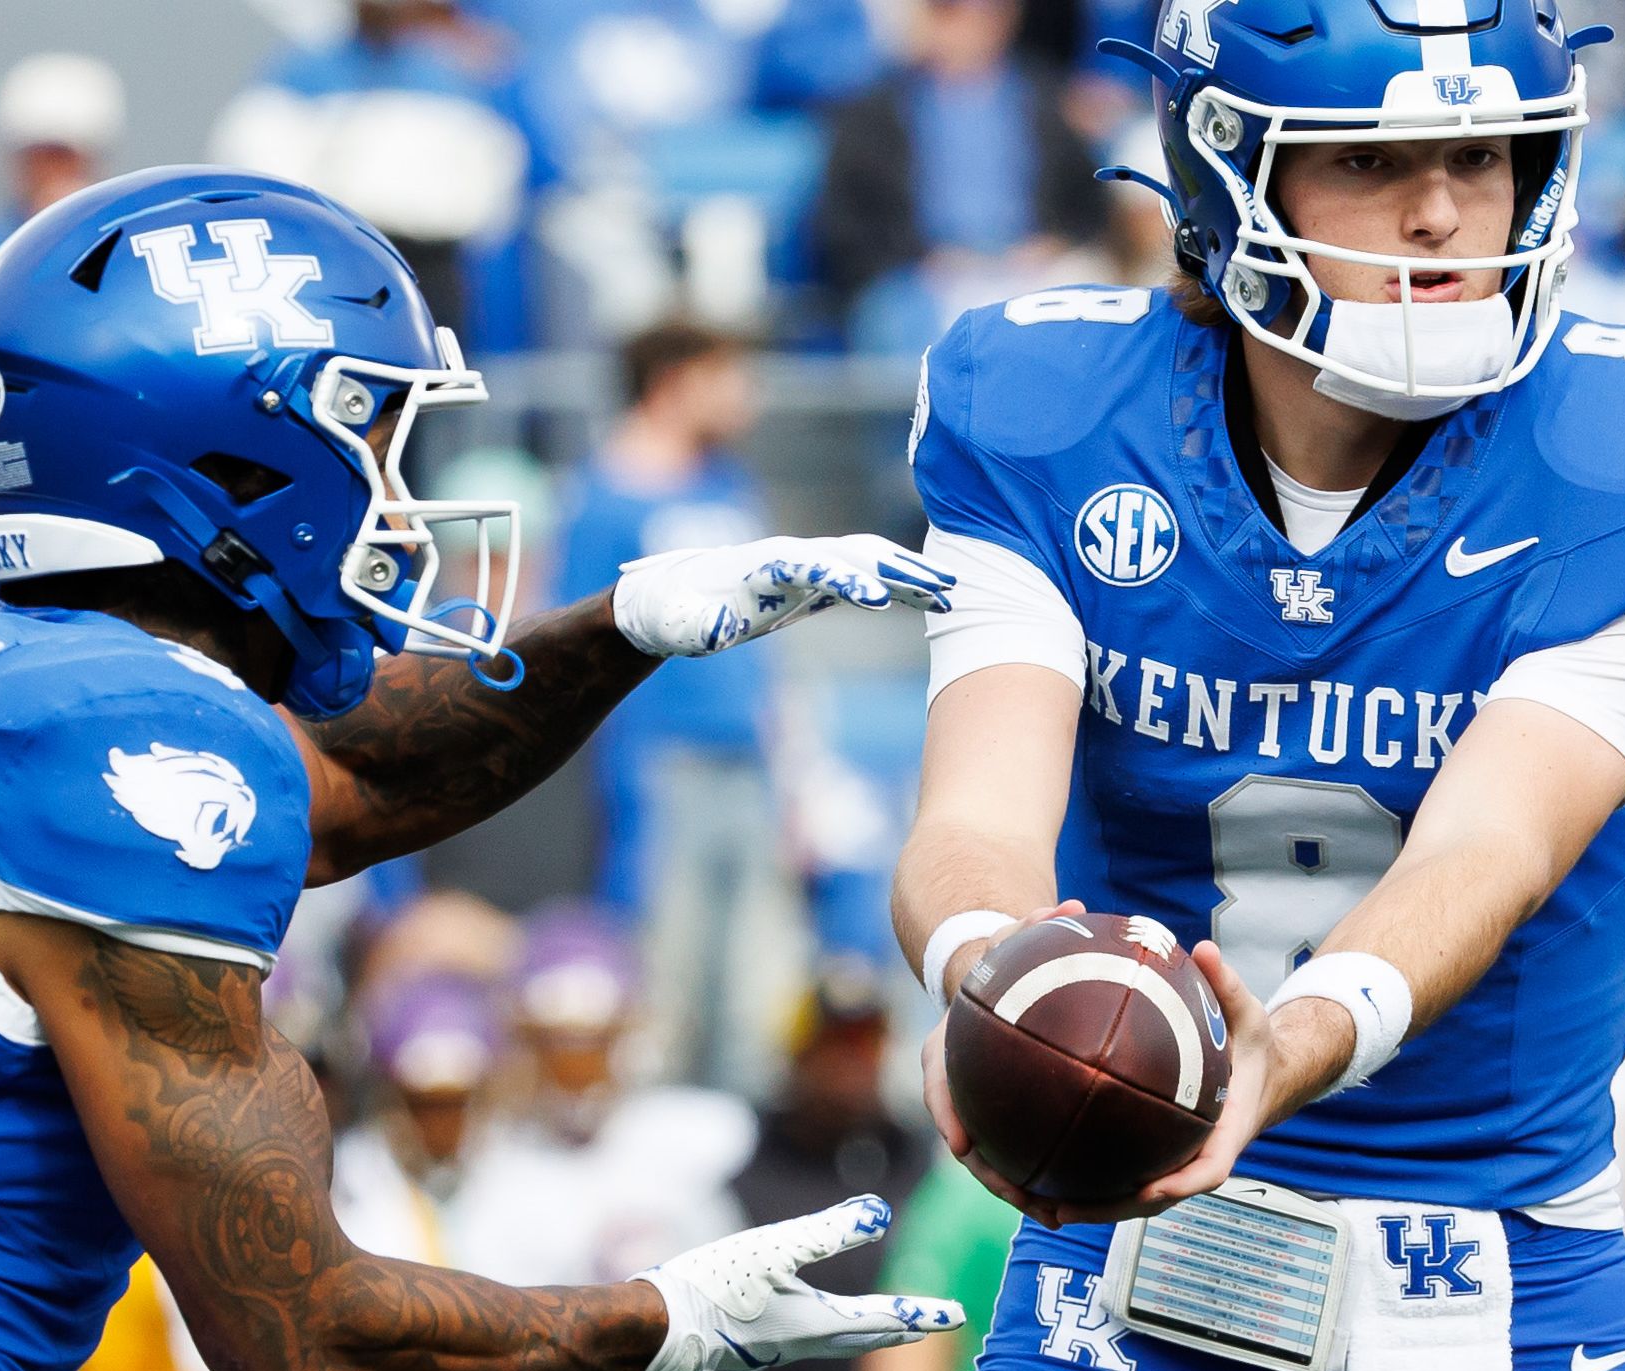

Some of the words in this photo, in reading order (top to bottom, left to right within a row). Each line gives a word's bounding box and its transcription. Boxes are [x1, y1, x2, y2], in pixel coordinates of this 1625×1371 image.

[131, 219, 335, 357] UK
[1003, 288, 1153, 328] 8
[1084, 491, 1173, 580] SEC
[1270, 568, 1335, 624] UK
[1086, 640, 1487, 769] KENTUCK
[1376, 1214, 1483, 1300] UK
